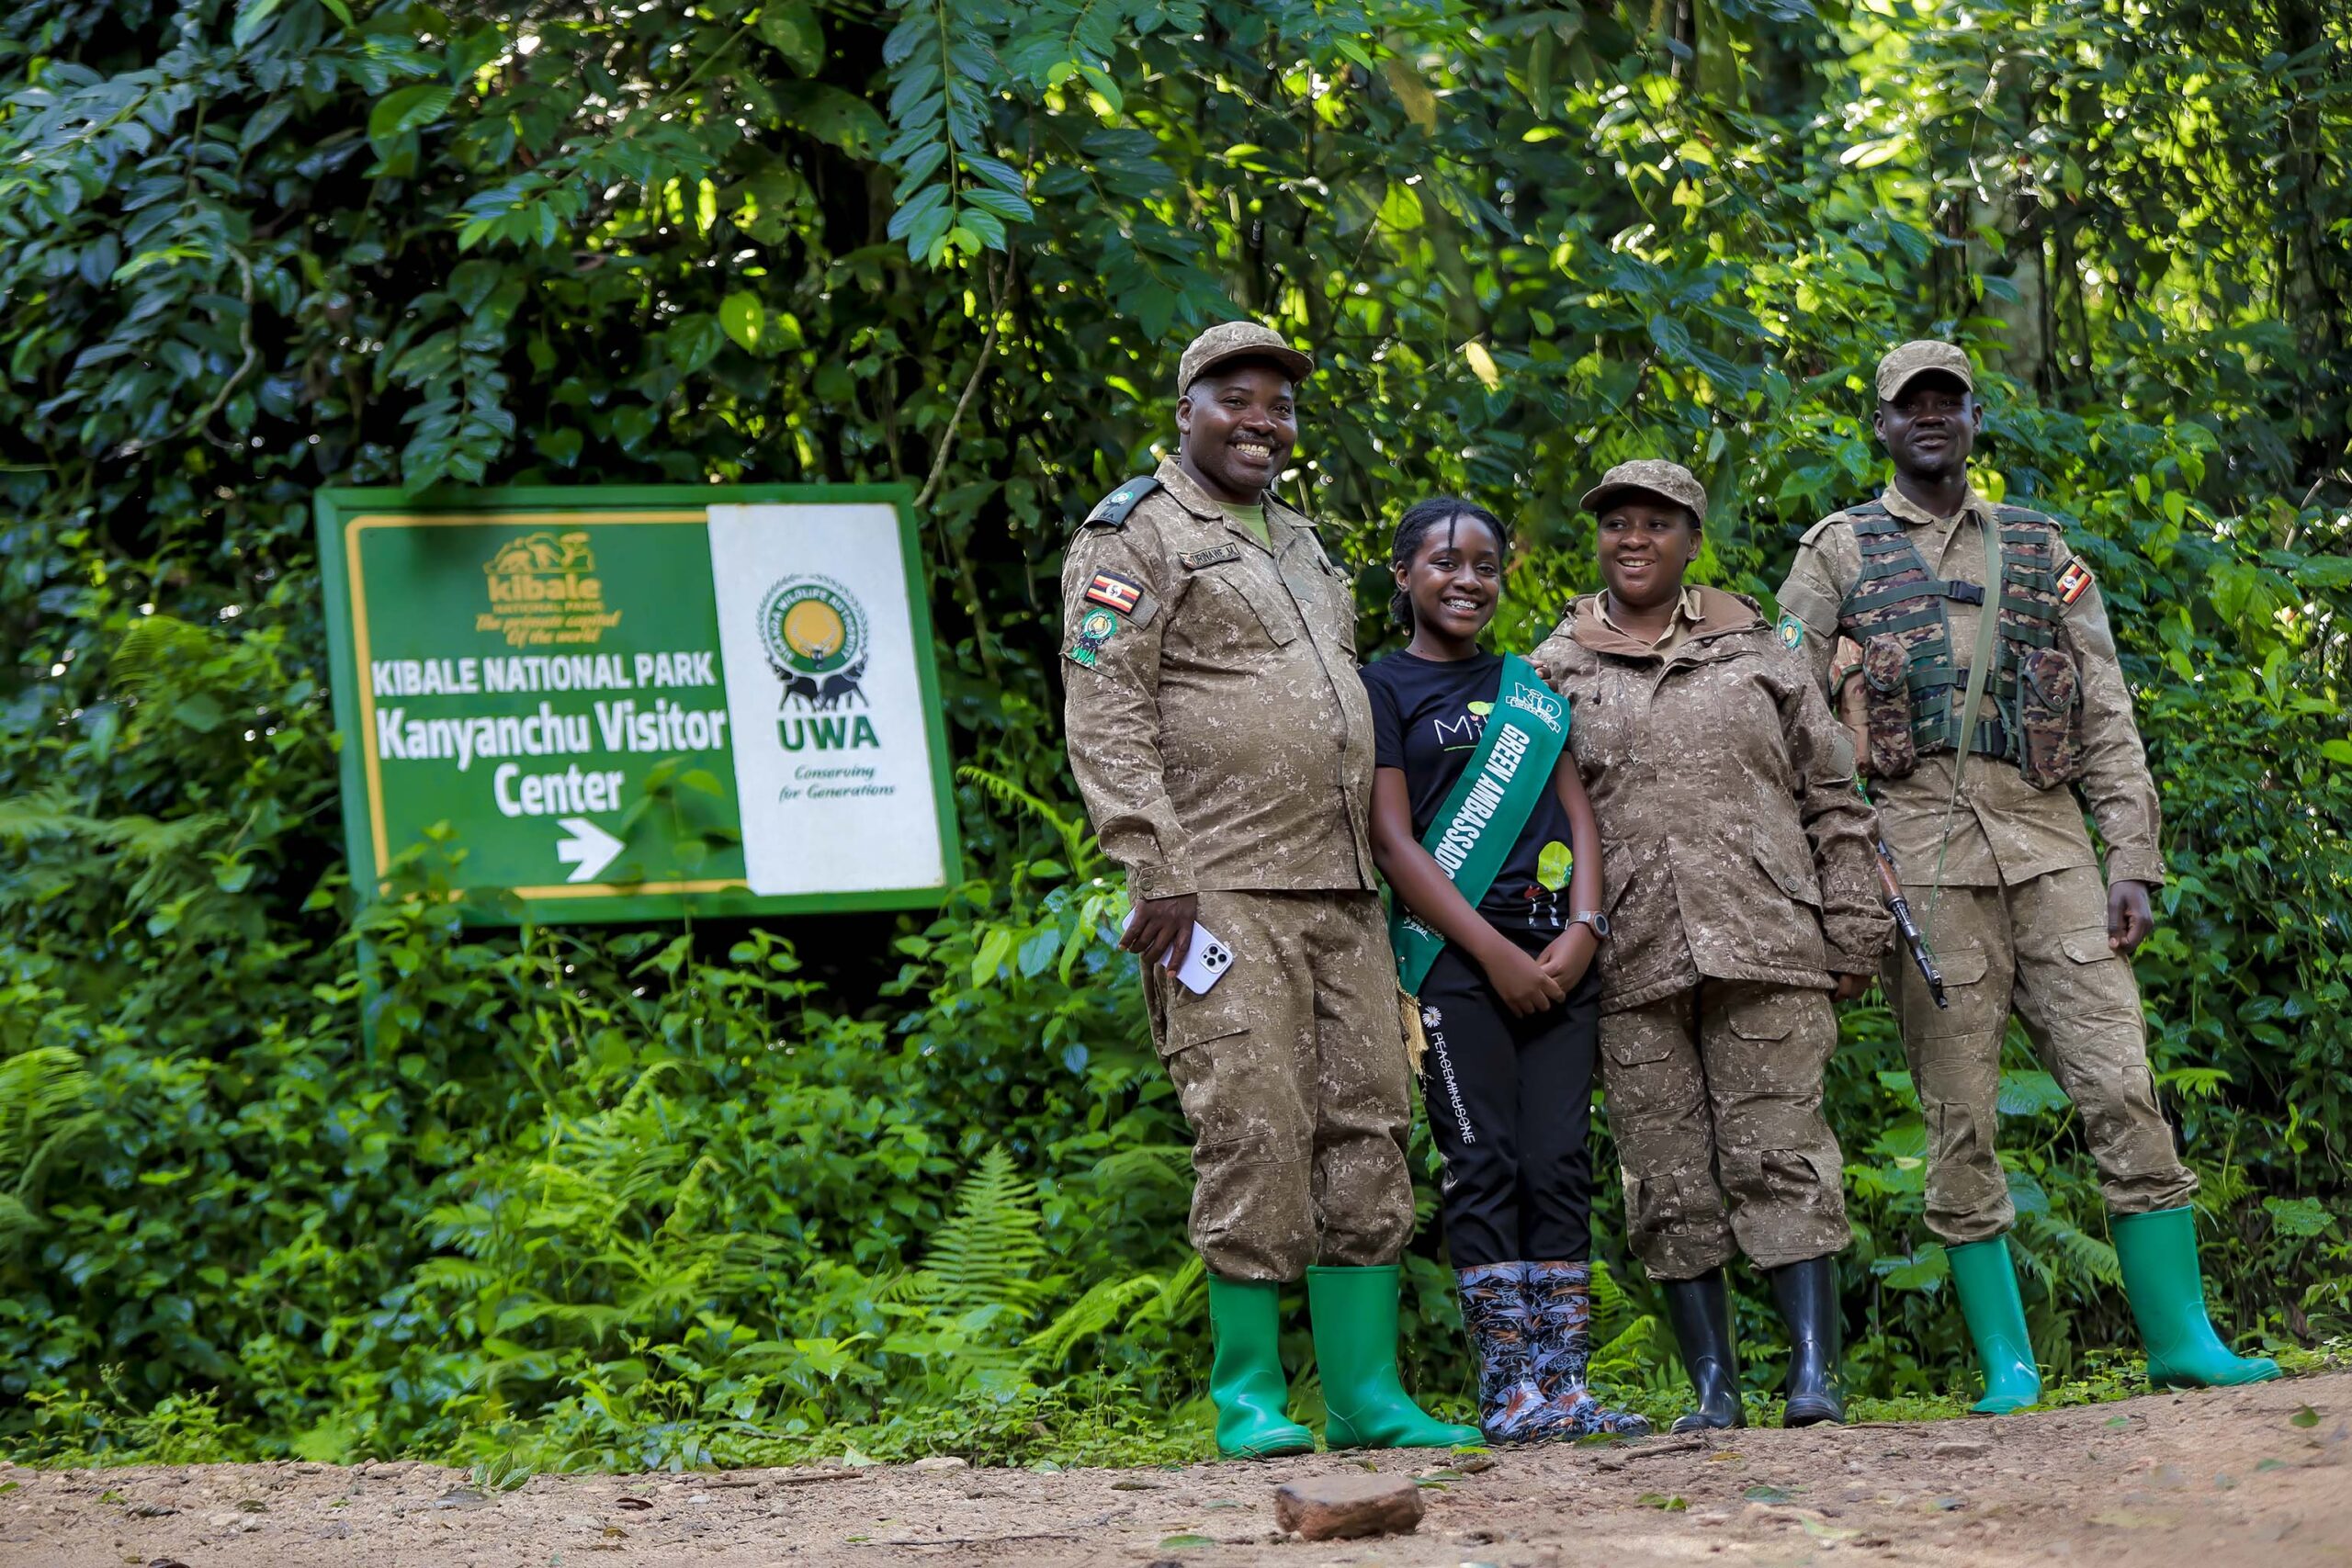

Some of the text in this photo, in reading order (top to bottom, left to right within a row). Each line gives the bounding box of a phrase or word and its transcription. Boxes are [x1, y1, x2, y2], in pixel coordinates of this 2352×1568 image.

[487, 572, 602, 602] kibale
[476, 609, 623, 634] The primate capital
[528, 628, 553, 644] the
[555, 626, 603, 644] world
[770, 588, 857, 662] UGANDA WILDLIFE AUTHORITY
[371, 650, 717, 697] KIBALE NATIONAL PARK
[376, 697, 728, 772] Kanyanchu Visitor
[777, 715, 880, 751] UWA
[1485, 723, 1530, 784] GREEN
[493, 761, 625, 818] Center
[795, 764, 876, 782] Conserving
[778, 784, 896, 804] for Generations
[1430, 1032, 1476, 1145] PEACEMINUSONE
